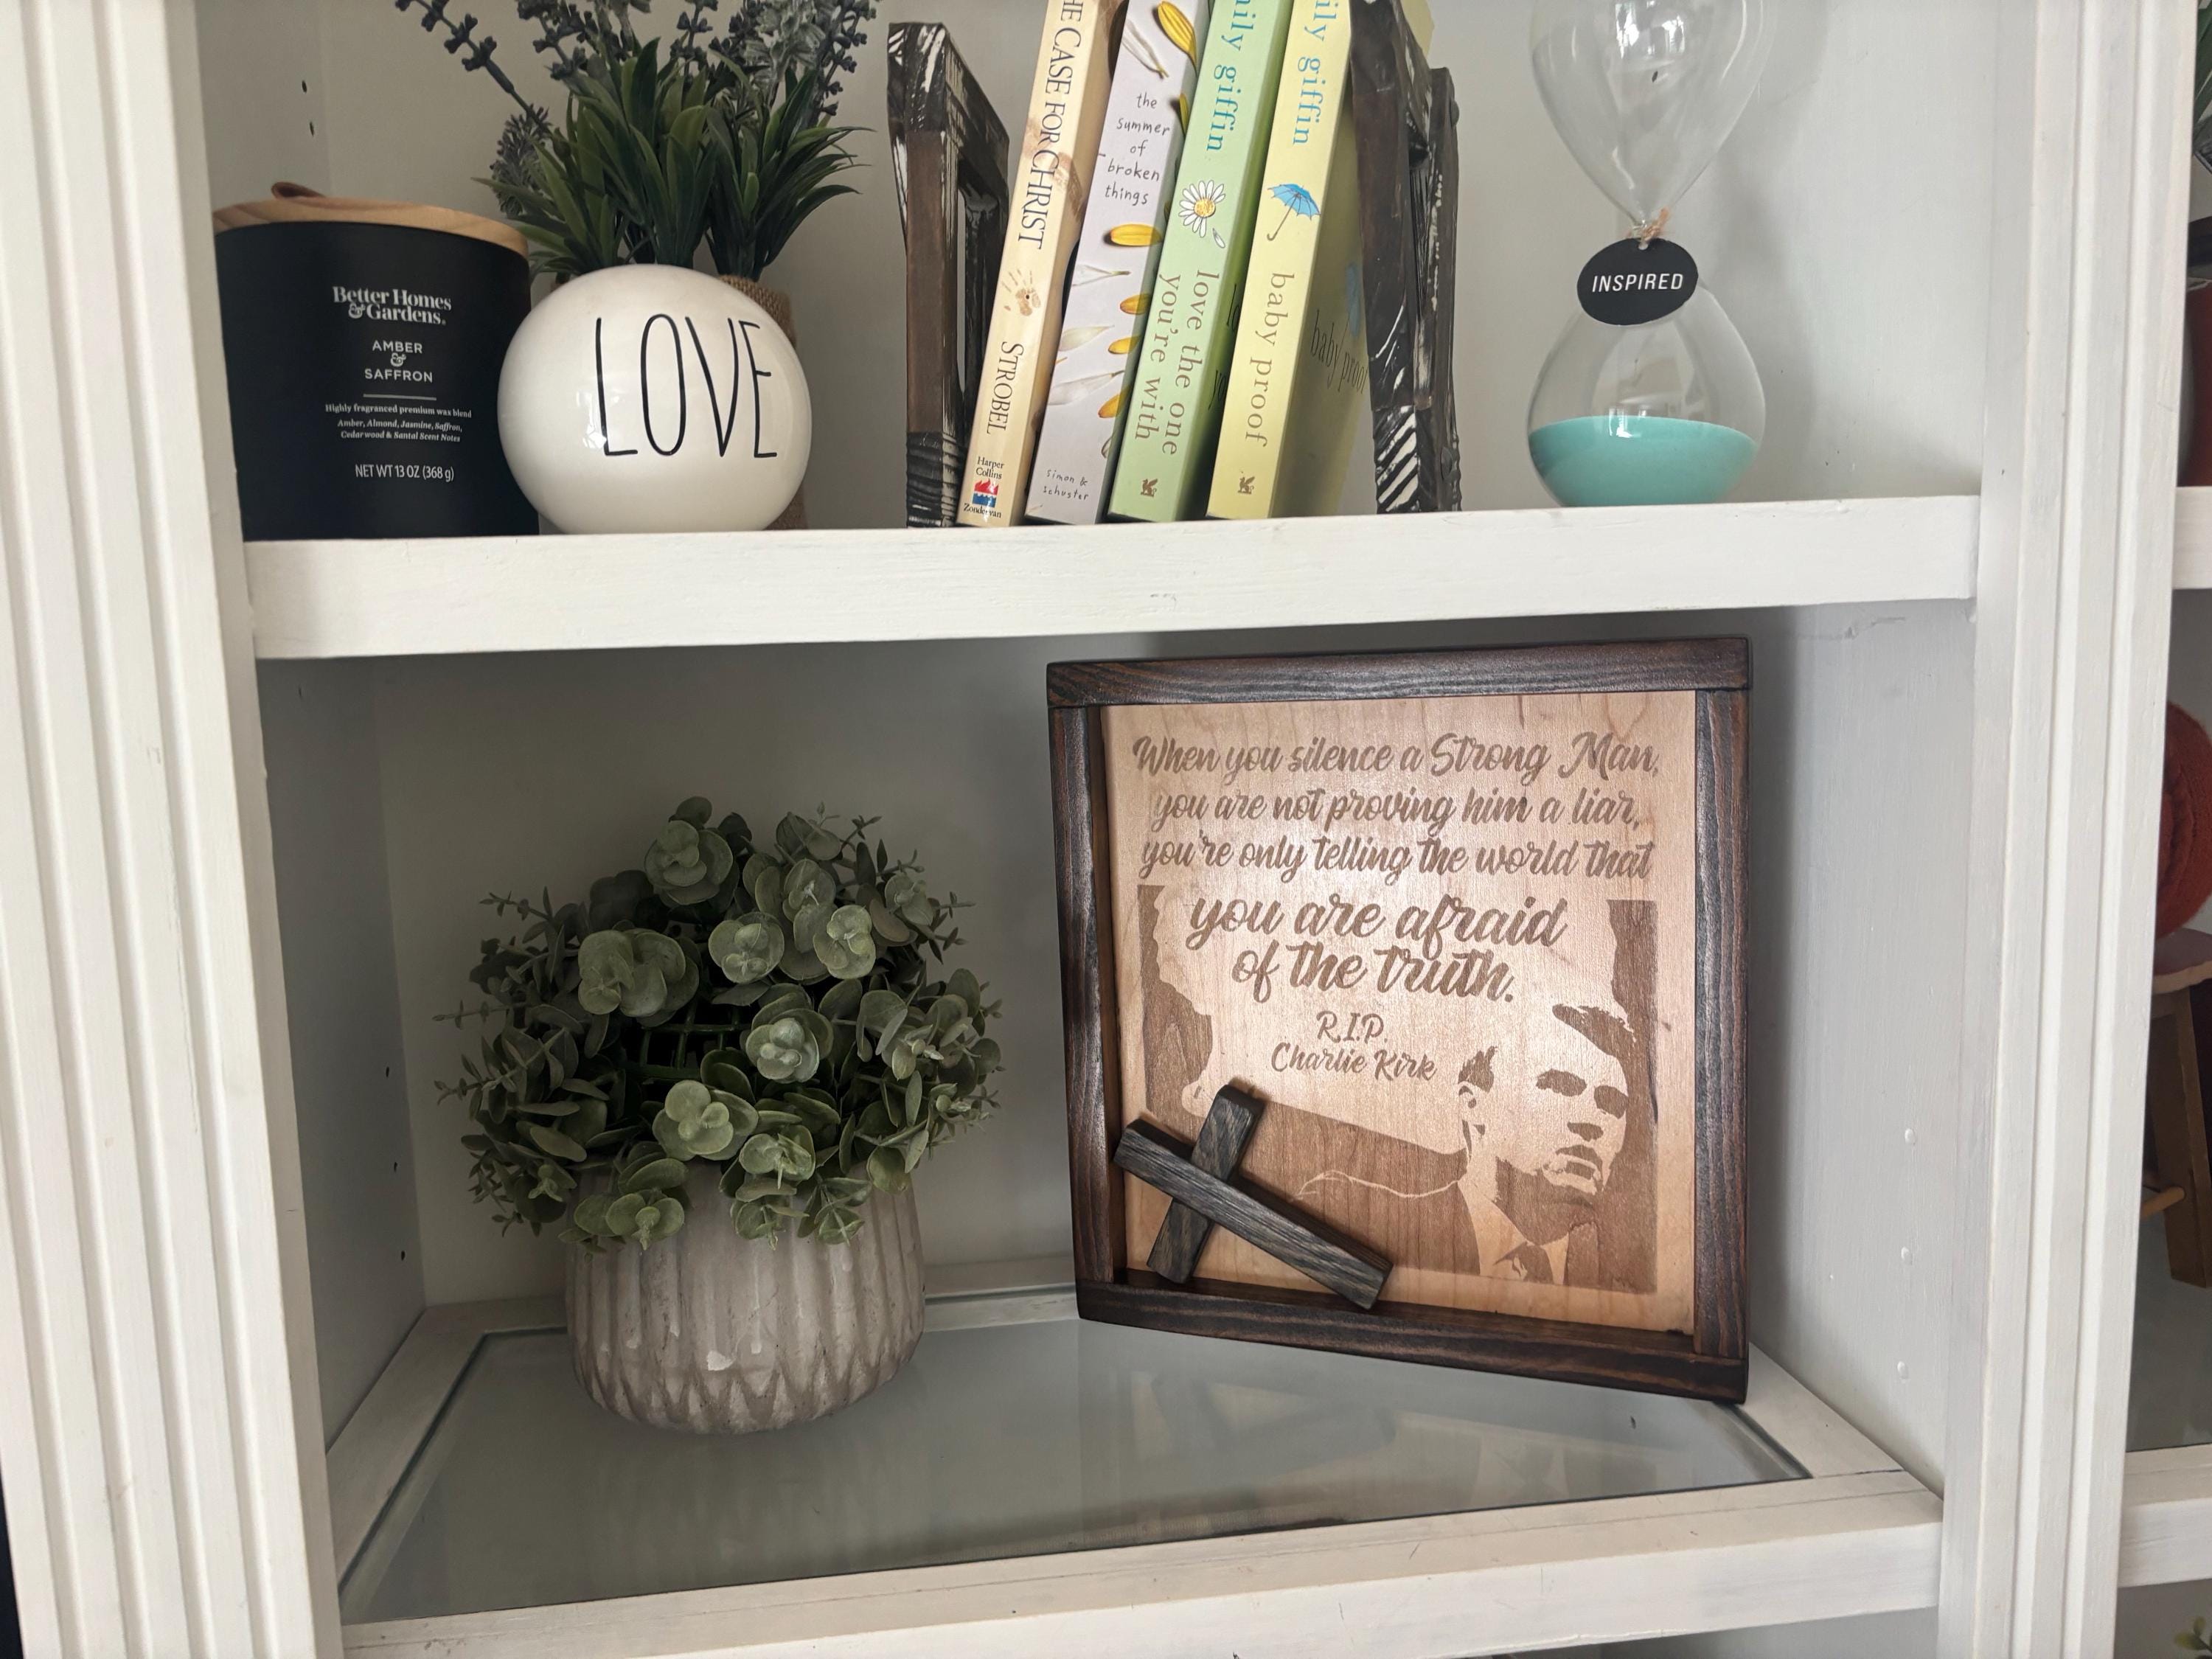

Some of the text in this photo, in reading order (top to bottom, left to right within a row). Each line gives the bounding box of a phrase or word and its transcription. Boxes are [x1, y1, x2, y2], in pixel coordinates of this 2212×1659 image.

[1045, 27, 1082, 94] CASE
[1137, 92, 1157, 109] the
[1206, 64, 1242, 151] giffin
[1293, 56, 1326, 145] giffin
[1037, 102, 1065, 145] FOR
[1130, 140, 1148, 157] of
[1107, 158, 1160, 181] broken
[1018, 150, 1060, 249] CHRIST
[1105, 181, 1149, 206] things
[333, 286, 452, 311] Better Homes
[1592, 273, 1684, 293] INSPIRED
[372, 340, 423, 354] AMBER
[390, 352, 406, 367] &
[1135, 274, 1181, 440] you're with
[1162, 270, 1220, 455] love the one
[1245, 273, 1295, 448] baby proof
[1310, 309, 1351, 390] baby
[364, 368, 434, 383] SAFFRON
[596, 313, 778, 459] LOVE
[987, 341, 1024, 435] STROBEL
[324, 403, 352, 414] Highly
[353, 403, 398, 415] fragranced
[399, 405, 435, 415] premium
[452, 408, 472, 419] blend
[337, 418, 462, 433] Amber, Almond, Jasmine, Saffron,
[386, 431, 392, 439] &
[394, 431, 419, 441] Santal
[420, 431, 439, 442] Scent
[440, 434, 461, 443] Notes
[355, 464, 455, 483] NET WT 13 OZ (368 g)
[975, 467, 1002, 480] Collins
[977, 456, 1004, 470] Harper
[1079, 476, 1088, 487] &
[1132, 731, 1660, 787] When you silence a Strong Man,
[1151, 787, 1641, 838] you are not proving him a liar,
[1138, 829, 1656, 886] you're only telling the world that
[1185, 893, 1569, 960] you are afraid
[1231, 939, 1516, 1004] of the truth.
[1315, 1010, 1388, 1043] R.I.P.
[1270, 1042, 1438, 1082] Charlie Kirk
